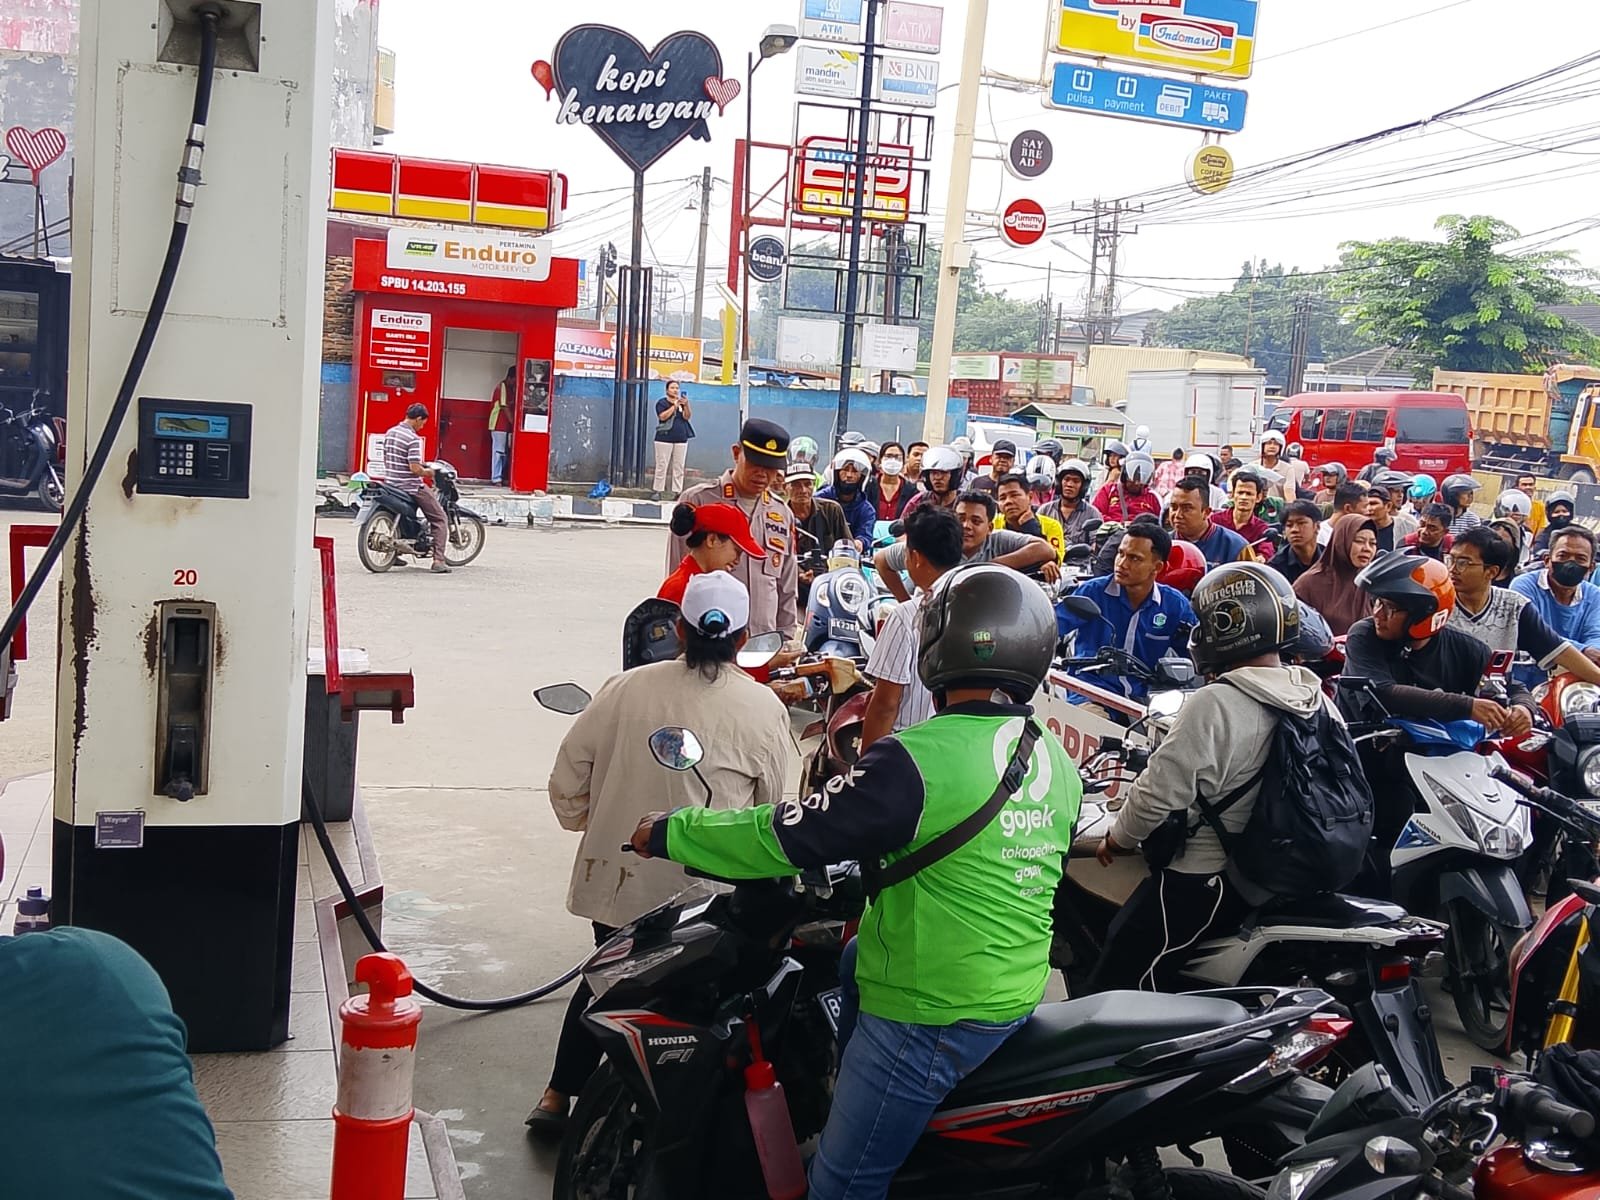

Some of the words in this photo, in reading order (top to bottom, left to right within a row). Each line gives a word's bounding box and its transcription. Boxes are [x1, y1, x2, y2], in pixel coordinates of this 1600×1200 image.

[821, 24, 842, 34] ATM
[897, 21, 932, 39] ATM
[1121, 14, 1137, 30] by
[1155, 26, 1216, 47] Indomaret
[596, 54, 670, 94] kopi
[805, 67, 840, 78] mandiri
[904, 63, 933, 80] BNI
[1066, 92, 1094, 105] pulsa
[1204, 90, 1232, 102] PAKET
[556, 87, 712, 130] kenangan
[1104, 98, 1145, 113] payment
[1159, 102, 1182, 114] DEBIT
[1022, 138, 1044, 149] SAY
[1021, 148, 1042, 159] BRE
[1019, 158, 1035, 167] AD
[444, 241, 537, 265] Enduro
[499, 241, 535, 249] PERTAMINA
[471, 263, 499, 271] MOTOR
[501, 265, 531, 273] SERVICE
[381, 276, 409, 289] SPBU
[411, 279, 465, 294] 14.203.155
[380, 315, 423, 326] Enduro
[559, 343, 616, 359] ALFAMART
[173, 569, 197, 586] 20
[1000, 804, 1057, 837] gojek
[1415, 819, 1442, 841] HONDA
[827, 995, 842, 1018] B
[648, 1035, 699, 1046] HONDA
[656, 1048, 695, 1065] FI
